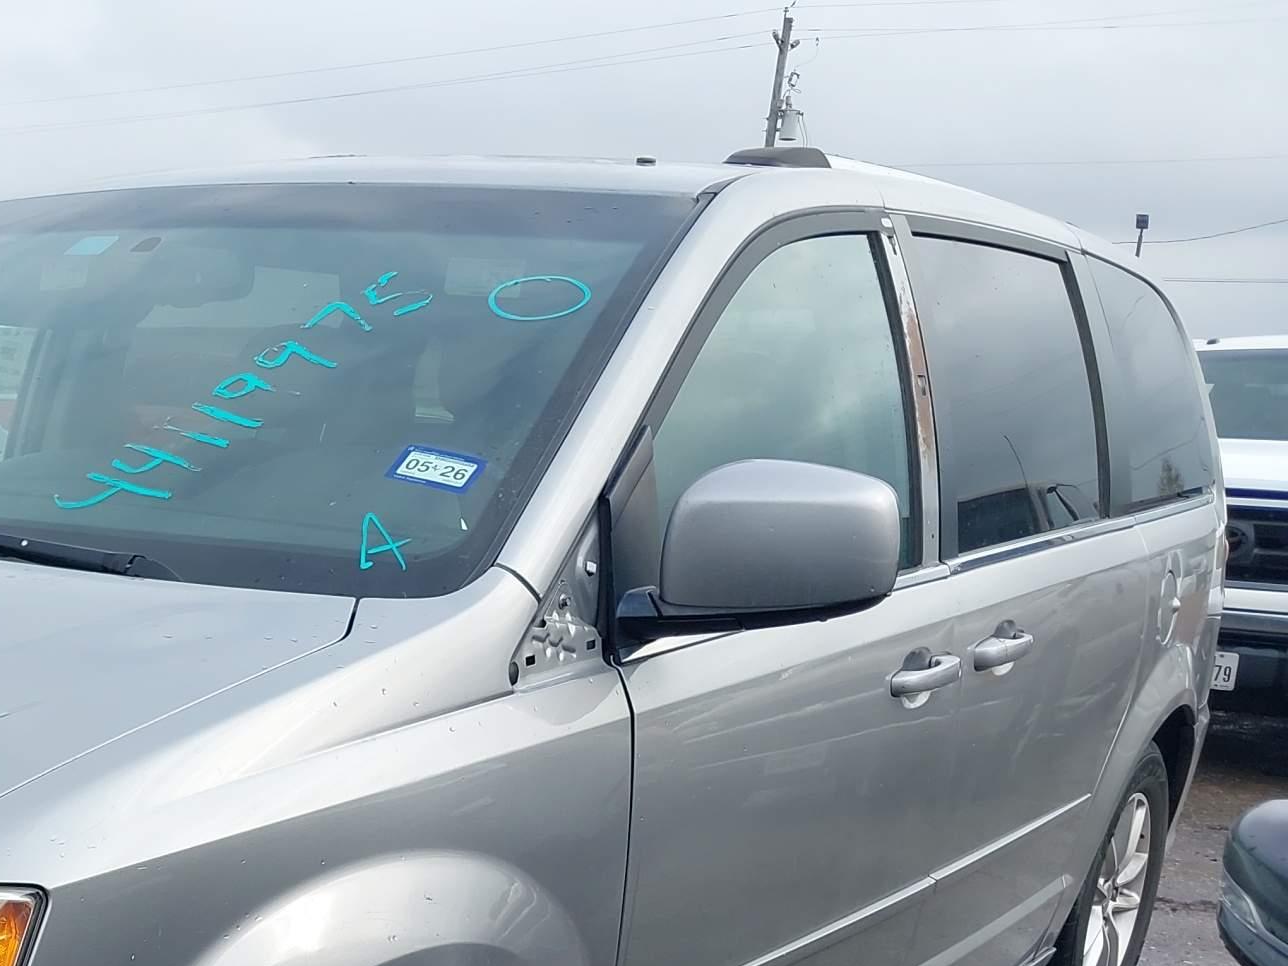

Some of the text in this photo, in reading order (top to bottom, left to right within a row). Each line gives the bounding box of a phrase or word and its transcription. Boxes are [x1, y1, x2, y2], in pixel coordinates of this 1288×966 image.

[405, 458, 433, 473] 05
[439, 465, 469, 481] 26
[360, 512, 410, 572] A
